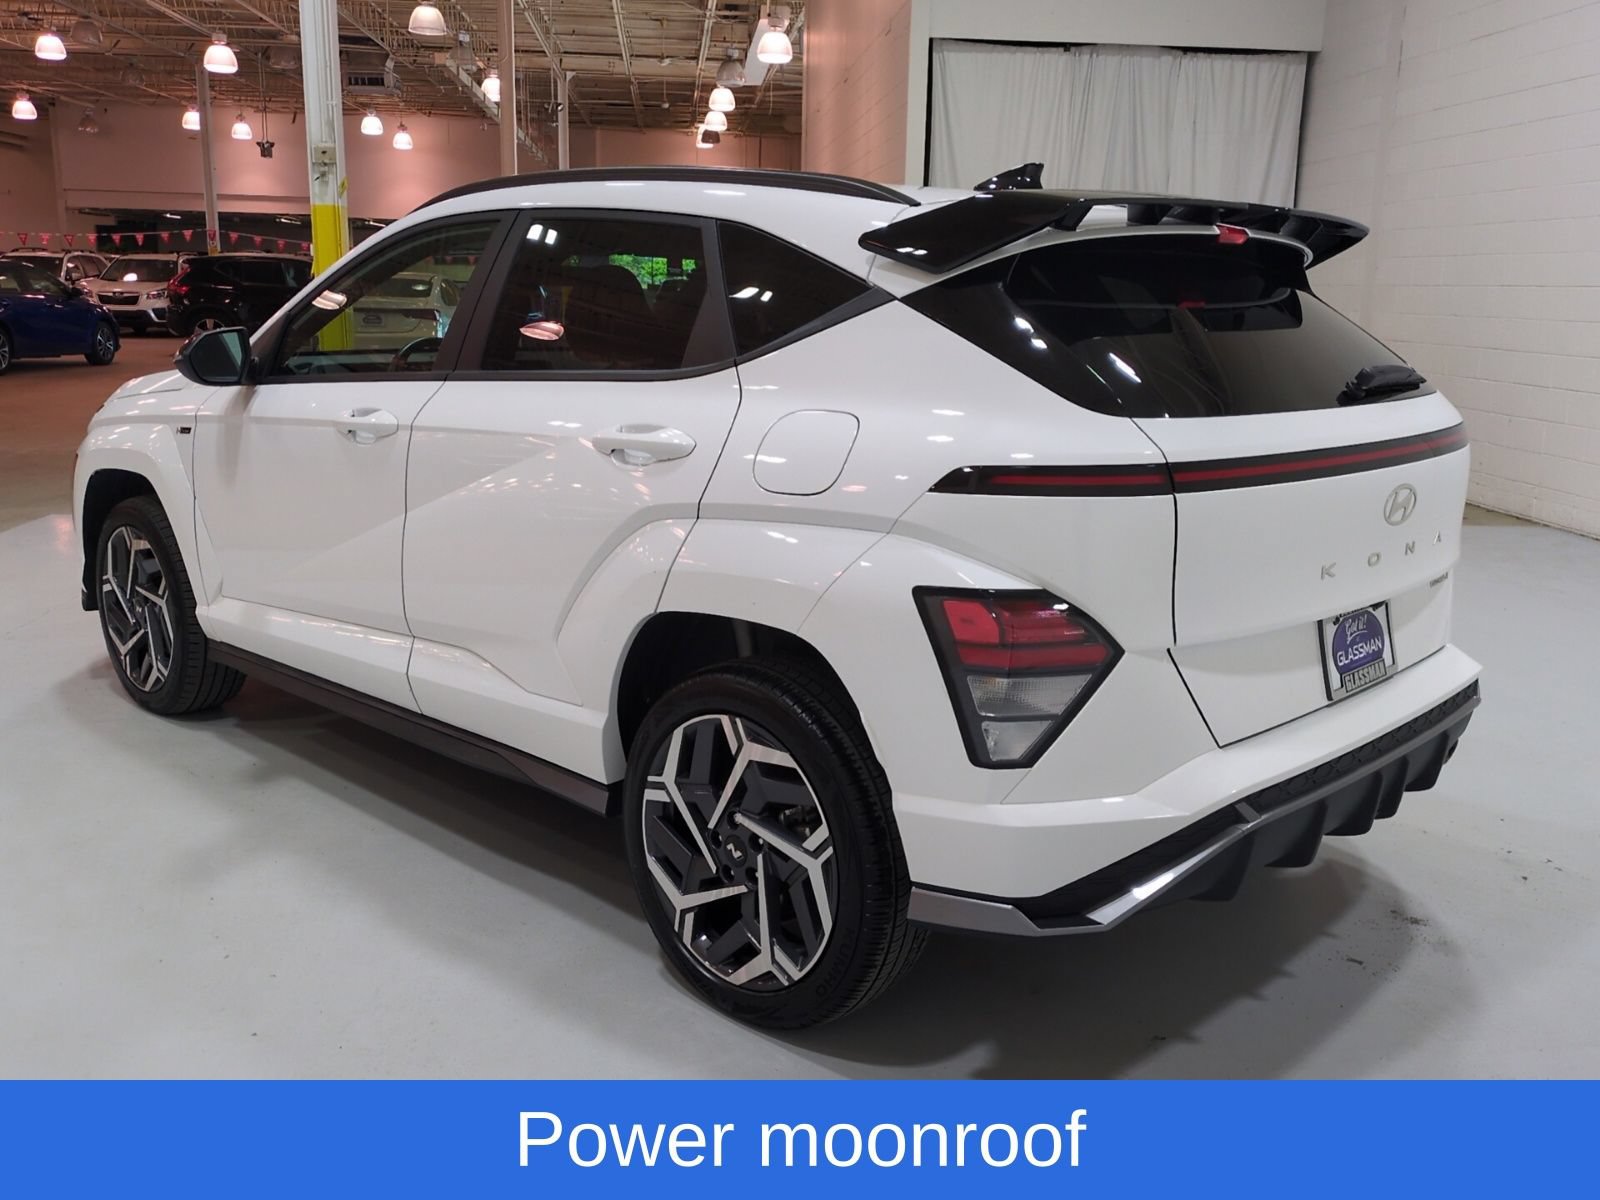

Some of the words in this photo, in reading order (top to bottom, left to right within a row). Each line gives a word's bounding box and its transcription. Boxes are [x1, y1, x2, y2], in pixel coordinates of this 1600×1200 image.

[1320, 531, 1442, 581] KONA
[1337, 635, 1382, 667] GLASSMAN
[1344, 660, 1386, 692] GLASSMAN
